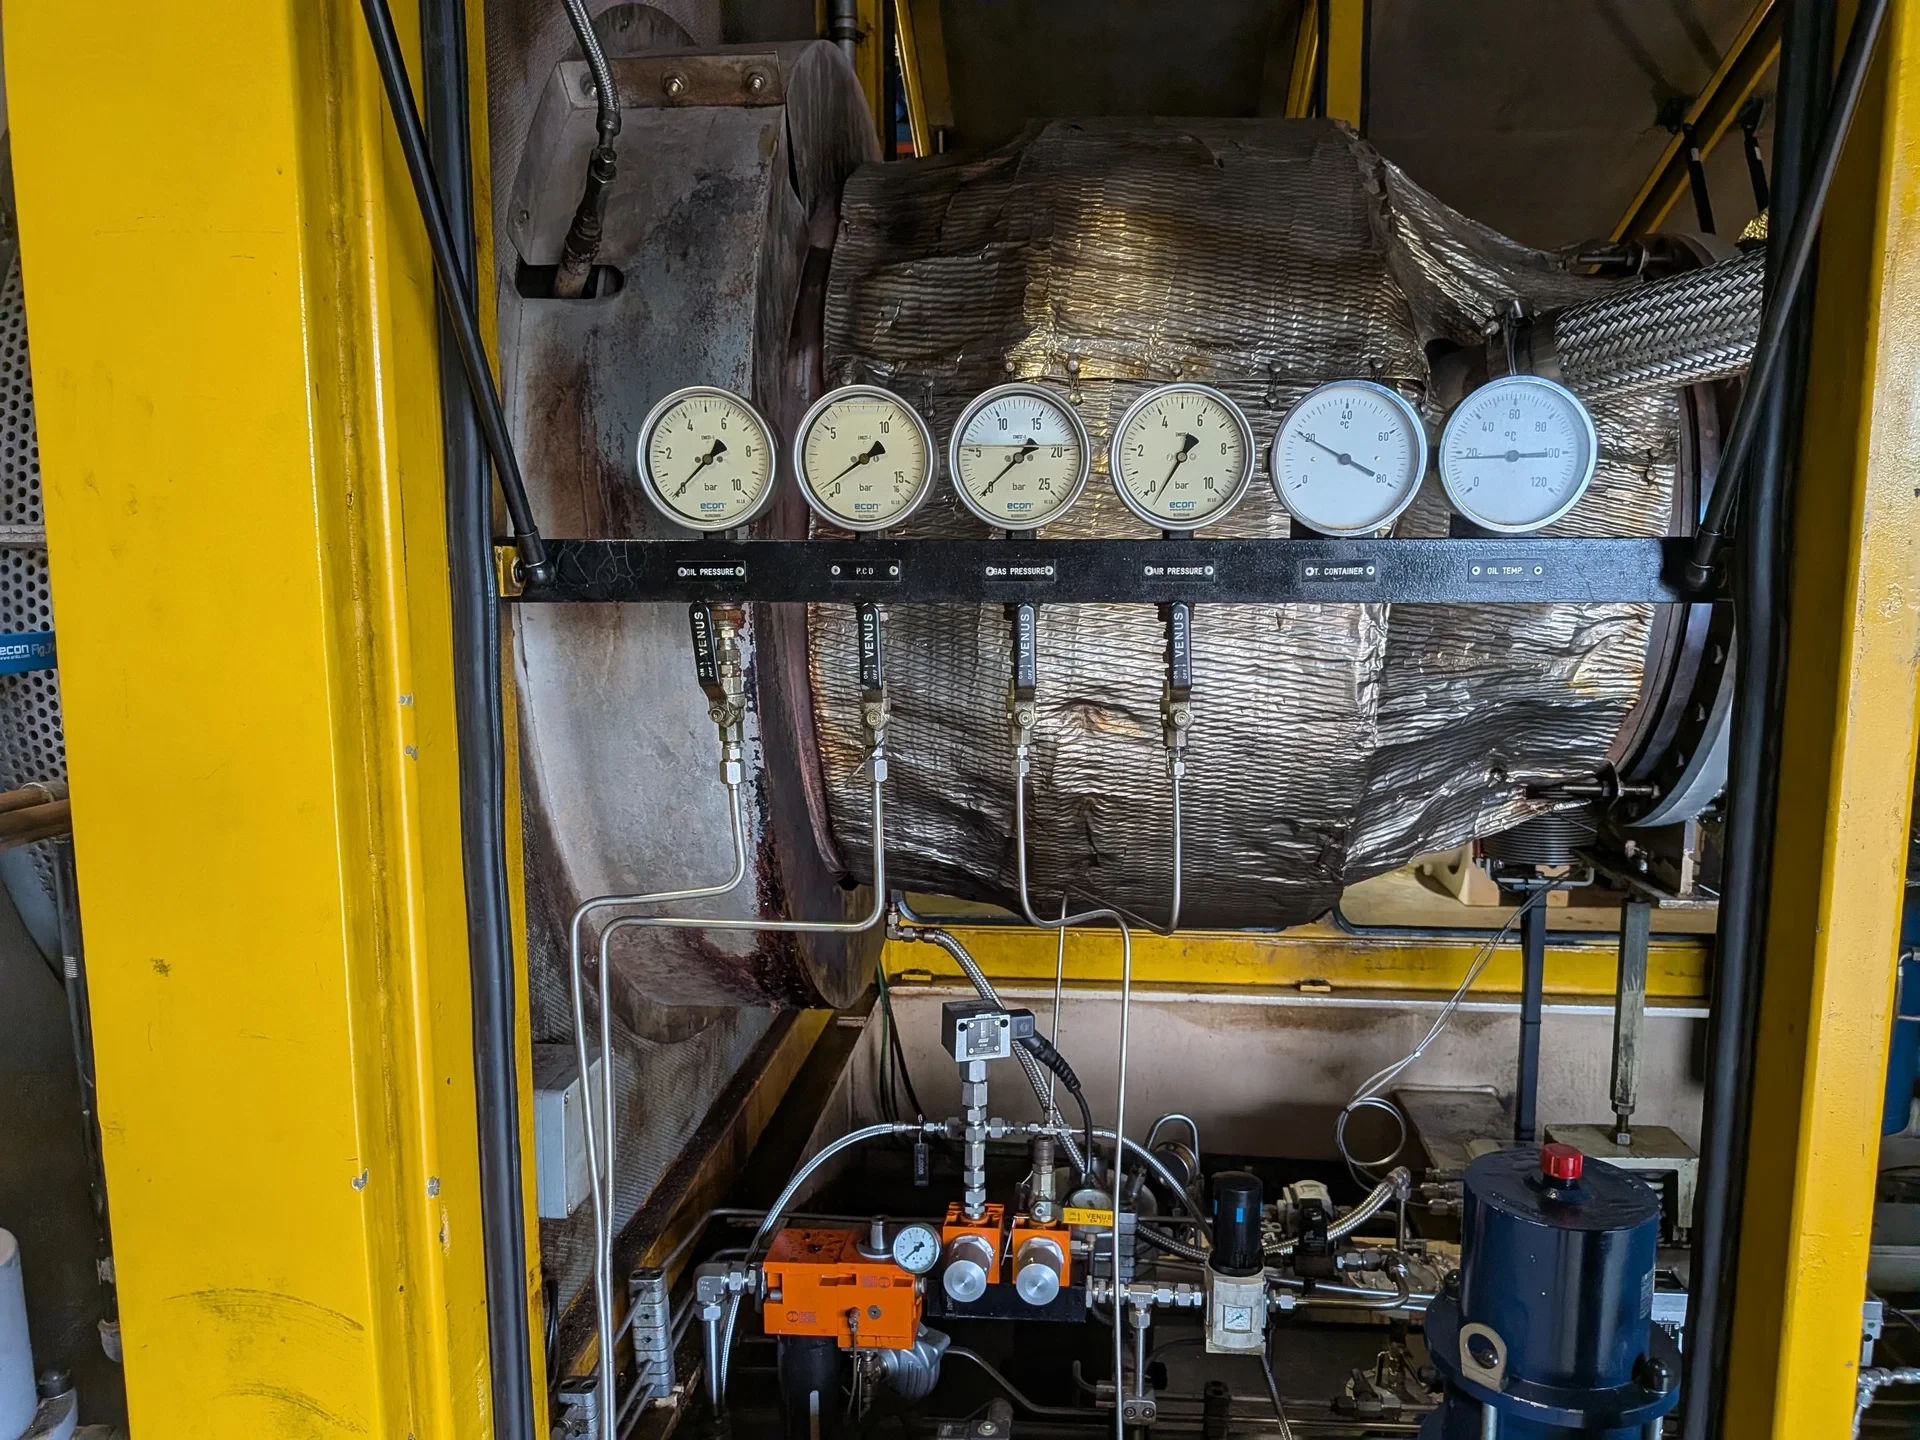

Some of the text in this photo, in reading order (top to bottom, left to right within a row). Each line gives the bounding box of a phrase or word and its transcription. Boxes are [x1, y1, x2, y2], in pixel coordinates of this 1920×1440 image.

[1197, 414, 1203, 426] 6
[1342, 410, 1352, 420] 40
[1509, 409, 1520, 419] 60
[687, 420, 694, 431] 4
[721, 418, 726, 429] 6
[880, 421, 889, 433] 10
[998, 418, 1007, 430] 10
[1032, 418, 1041, 430] 15
[1162, 416, 1168, 428] 4
[1482, 422, 1494, 432] 40
[1535, 422, 1546, 432] 80
[831, 427, 836, 439] 5
[1305, 433, 1315, 442] 20
[1378, 432, 1388, 441] 60
[666, 447, 672, 459] 2
[746, 445, 751, 457] 8
[976, 448, 981, 458] 5
[1051, 447, 1062, 458] 20
[1138, 445, 1144, 457] 2
[1221, 443, 1227, 455] 8
[1466, 448, 1477, 457] 20
[894, 471, 904, 483] 15
[1204, 477, 1213, 489] 10
[1303, 475, 1308, 483] 0
[1376, 474, 1386, 483] 80
[1474, 477, 1479, 487] 0
[1530, 477, 1547, 487] 120
[704, 483, 718, 491] bar
[731, 479, 742, 491] 10
[835, 483, 840, 494] 0
[1039, 478, 1050, 490] 25
[1150, 480, 1156, 492] 0
[700, 568, 734, 576] PRESSURE
[1152, 567, 1203, 575] AIR PRESSURE
[694, 612, 708, 656] VENUS
[864, 613, 874, 658] VENUS
[1021, 613, 1030, 658] VENUS
[1174, 612, 1184, 658] VENUS
[0, 644, 29, 656] econ
